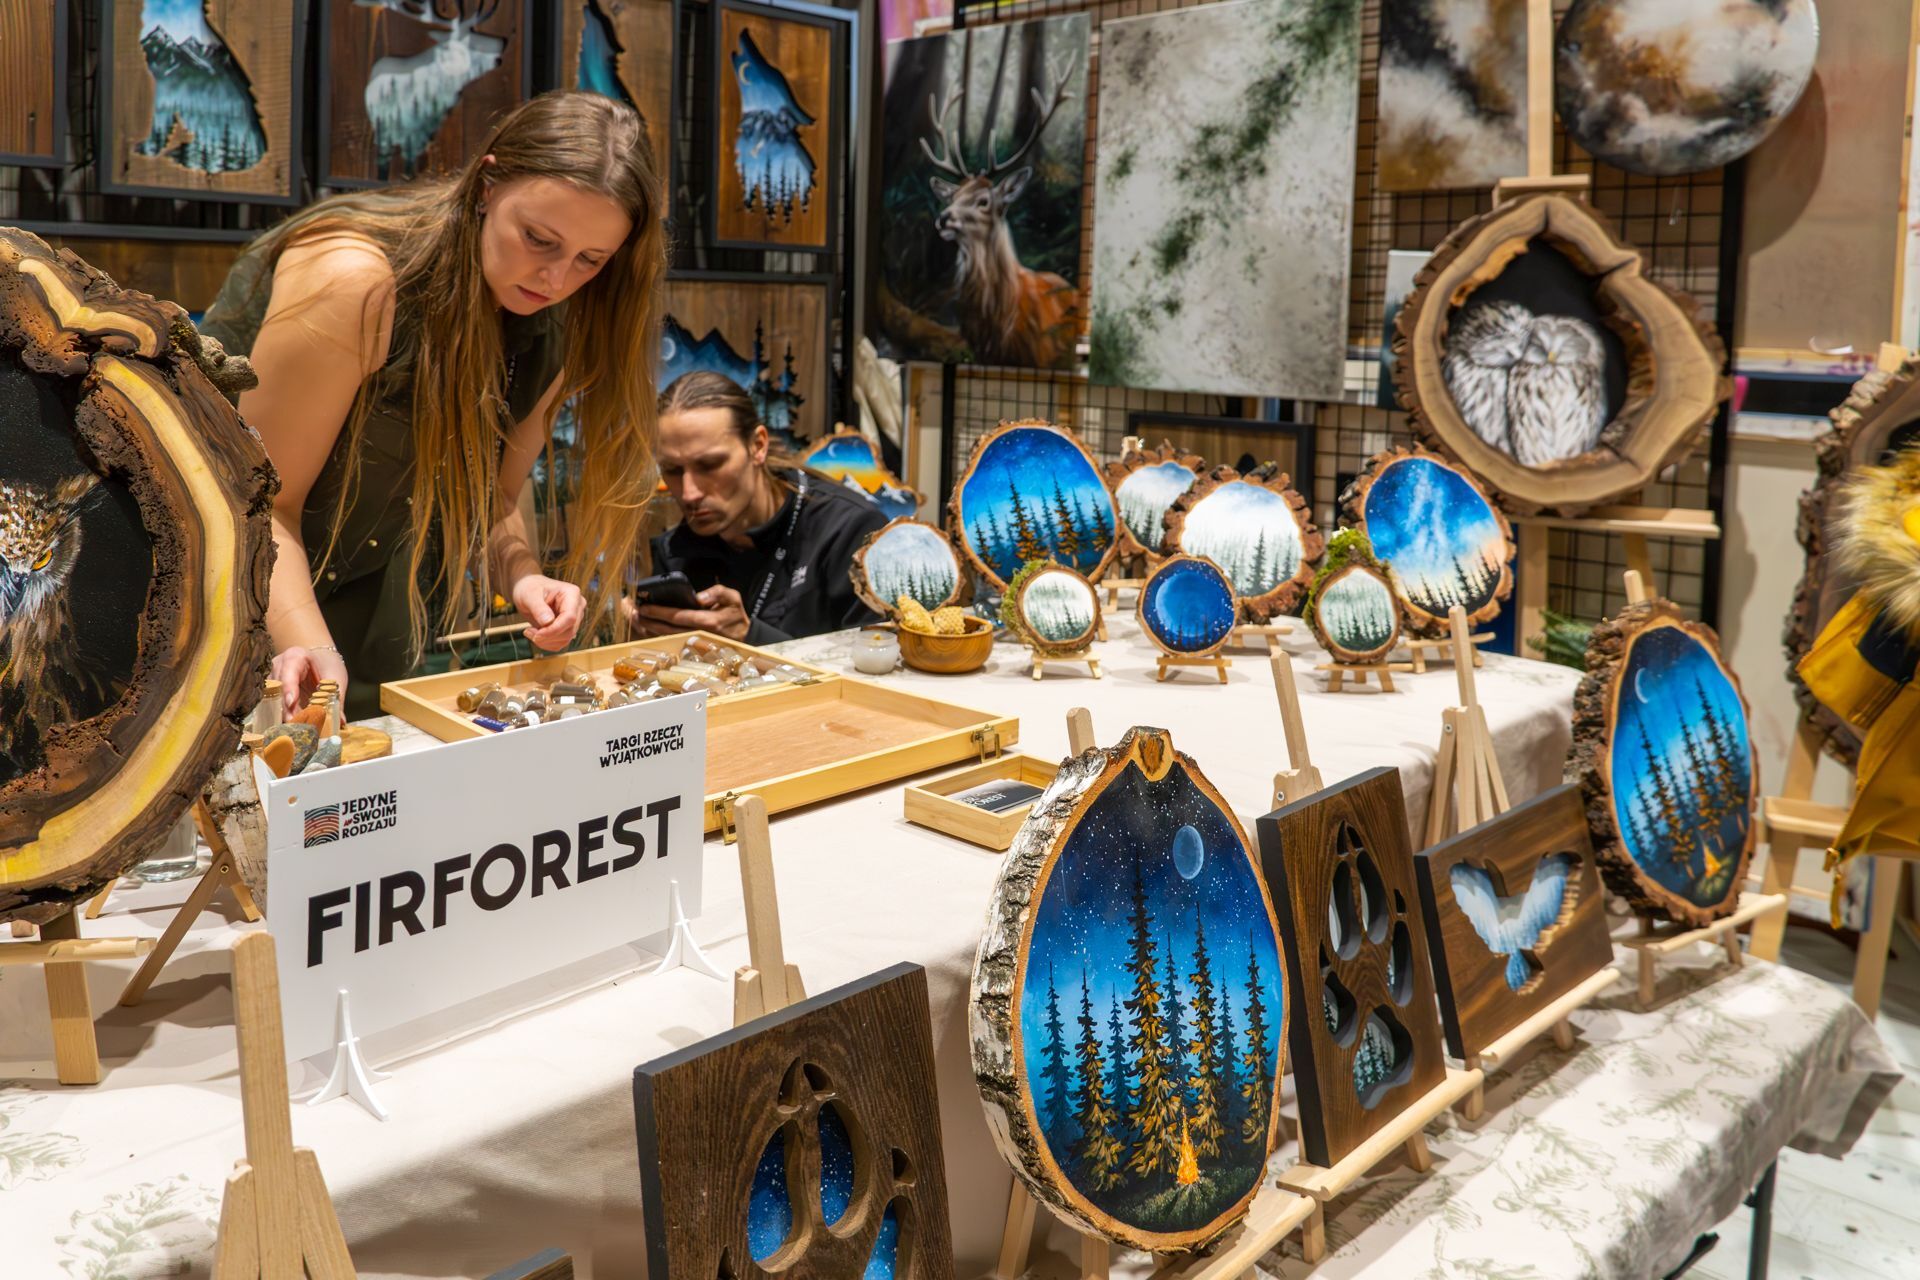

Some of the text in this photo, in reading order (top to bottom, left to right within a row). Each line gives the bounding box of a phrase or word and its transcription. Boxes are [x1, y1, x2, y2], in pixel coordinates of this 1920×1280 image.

[606, 723, 684, 753] TARGI RZECZY
[599, 737, 684, 768] WYJĄTKOWYCH
[341, 789, 397, 816] JEDYNE
[352, 804, 397, 825] SWOIM
[341, 816, 397, 839] RODZAJU
[307, 795, 681, 969] FIRFOREST
